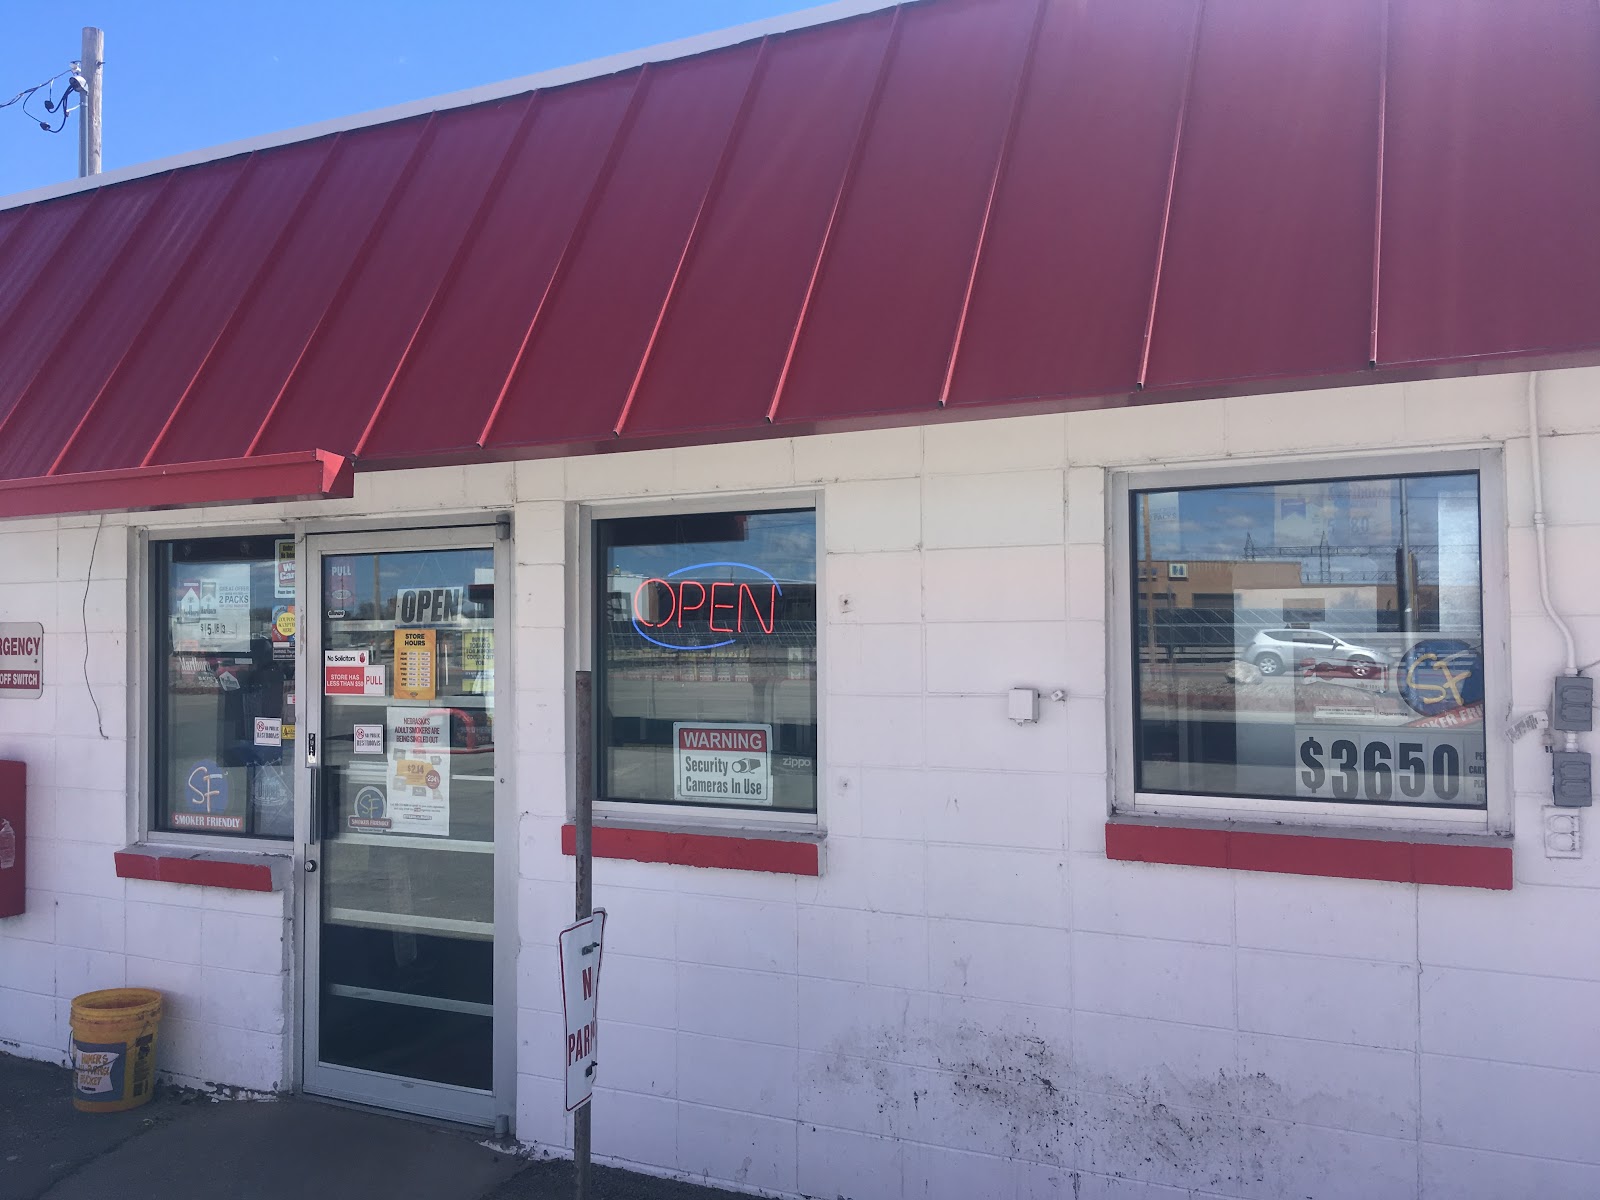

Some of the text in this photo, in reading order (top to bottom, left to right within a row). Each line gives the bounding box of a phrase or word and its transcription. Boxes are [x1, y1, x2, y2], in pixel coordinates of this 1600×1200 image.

[280, 572, 295, 580] Car
[331, 566, 351, 576] PULL
[219, 594, 249, 604] 2 PACKS
[401, 588, 460, 623] OPEN
[634, 578, 776, 634] OPEN
[12, 673, 37, 685] SWITCH
[365, 675, 383, 685] PULL
[403, 717, 430, 725] NEBRASKA'S
[409, 727, 431, 735] SMOKERS
[410, 735, 428, 743] SINGLED
[683, 731, 763, 750] WARNING
[685, 755, 729, 776] Security
[782, 757, 811, 769] zippo
[1300, 736, 1460, 801] $3650
[188, 766, 223, 813] SF
[685, 775, 762, 795] Cameras In Use
[360, 794, 380, 818] SF
[174, 814, 241, 828] SMOKER FRIENDLY
[582, 966, 592, 1001] N
